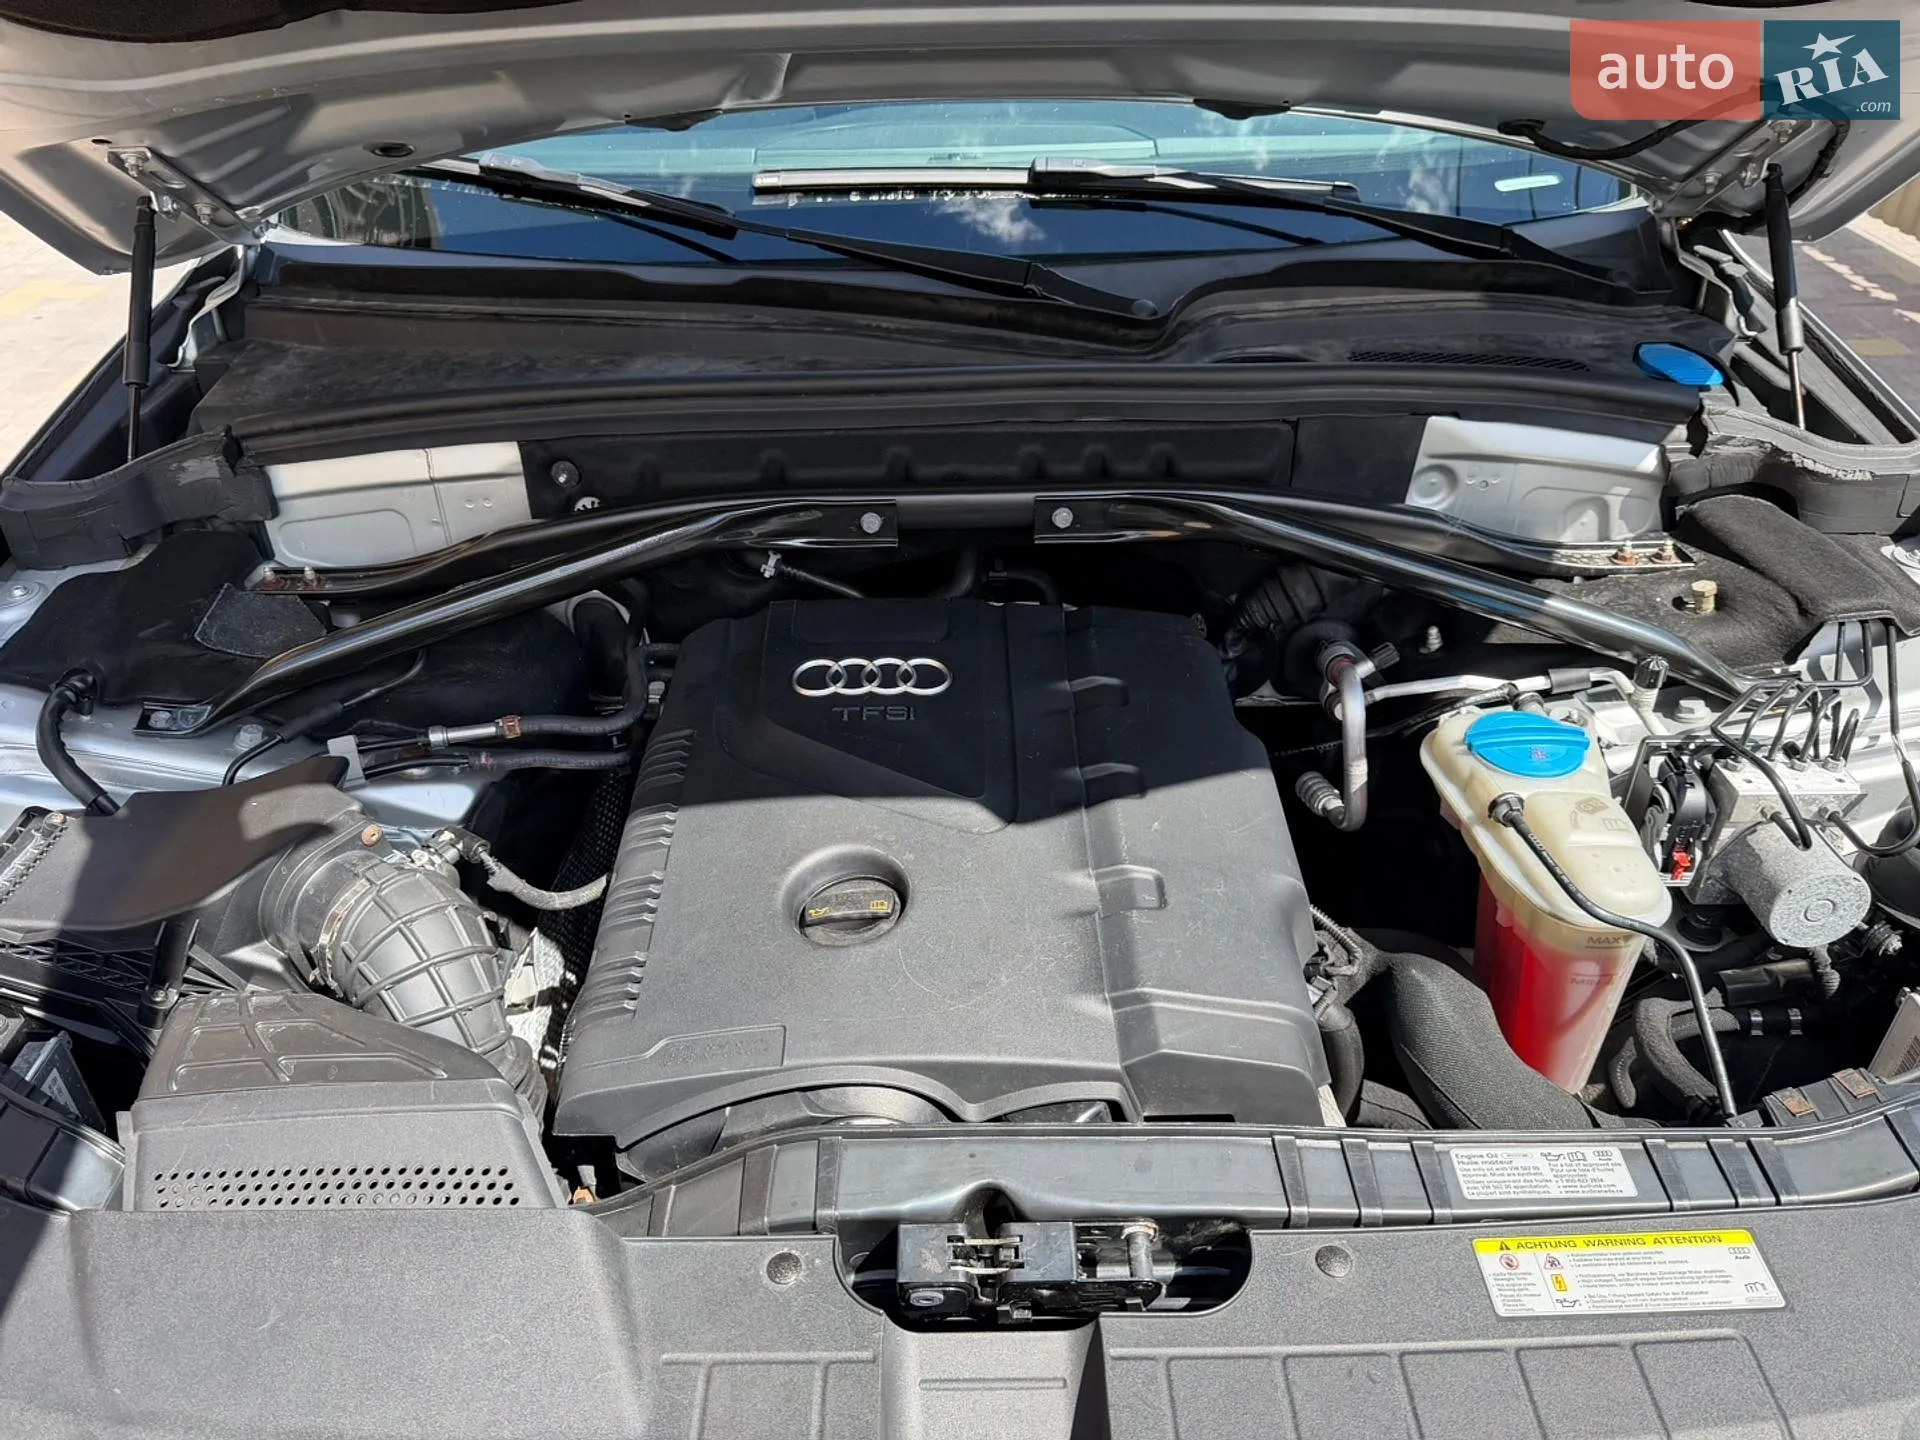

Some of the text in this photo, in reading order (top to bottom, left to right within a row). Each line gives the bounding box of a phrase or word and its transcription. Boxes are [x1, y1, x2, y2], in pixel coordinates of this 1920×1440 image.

[831, 705, 915, 721] TFSI
[1587, 936, 1621, 944] MAX
[1516, 1235, 1722, 1249] ACHTUNG WARNING ATTENTION
